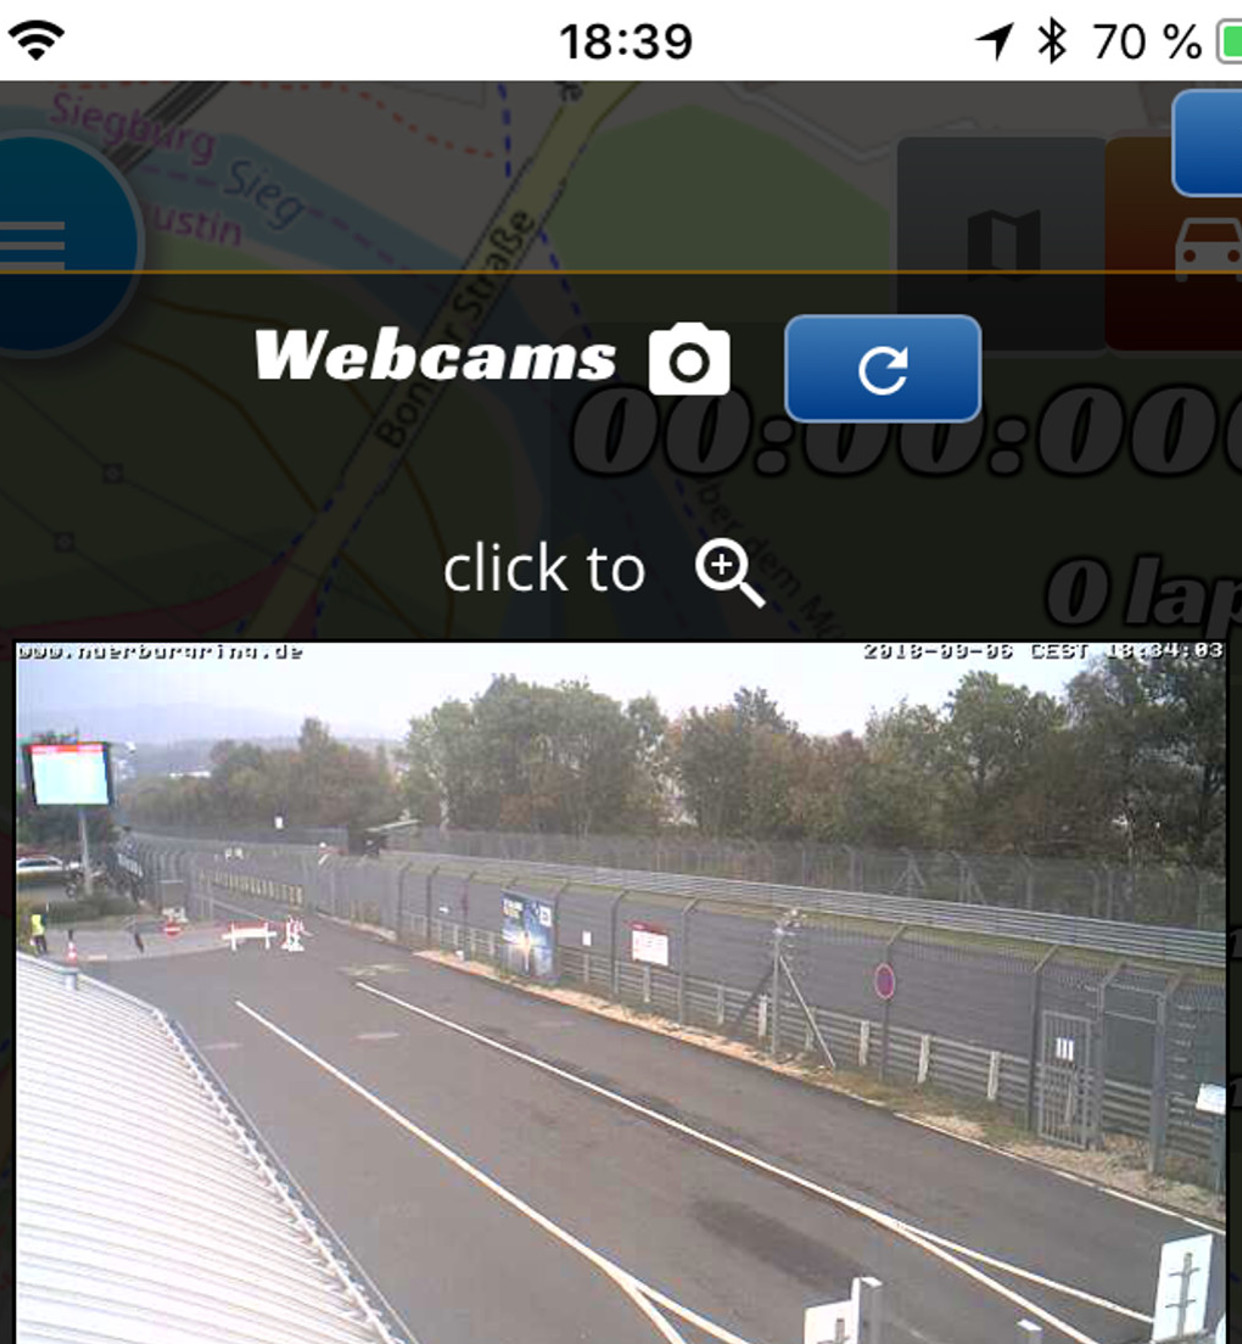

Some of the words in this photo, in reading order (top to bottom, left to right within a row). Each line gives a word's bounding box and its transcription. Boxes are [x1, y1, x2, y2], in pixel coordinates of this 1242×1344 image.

[560, 23, 693, 60] 18:39
[1093, 23, 1146, 60] 70
[1163, 23, 1203, 60] %
[50, 92, 217, 166] Siegburg
[152, 204, 242, 247] ustin
[223, 160, 305, 231] Sieg
[255, 326, 617, 381] Webcams
[373, 323, 465, 449] Bonr
[452, 209, 536, 322] Straße
[567, 382, 1242, 478] 00:00:00
[444, 541, 569, 592] click
[586, 546, 645, 592] to
[1045, 554, 1111, 628] 0
